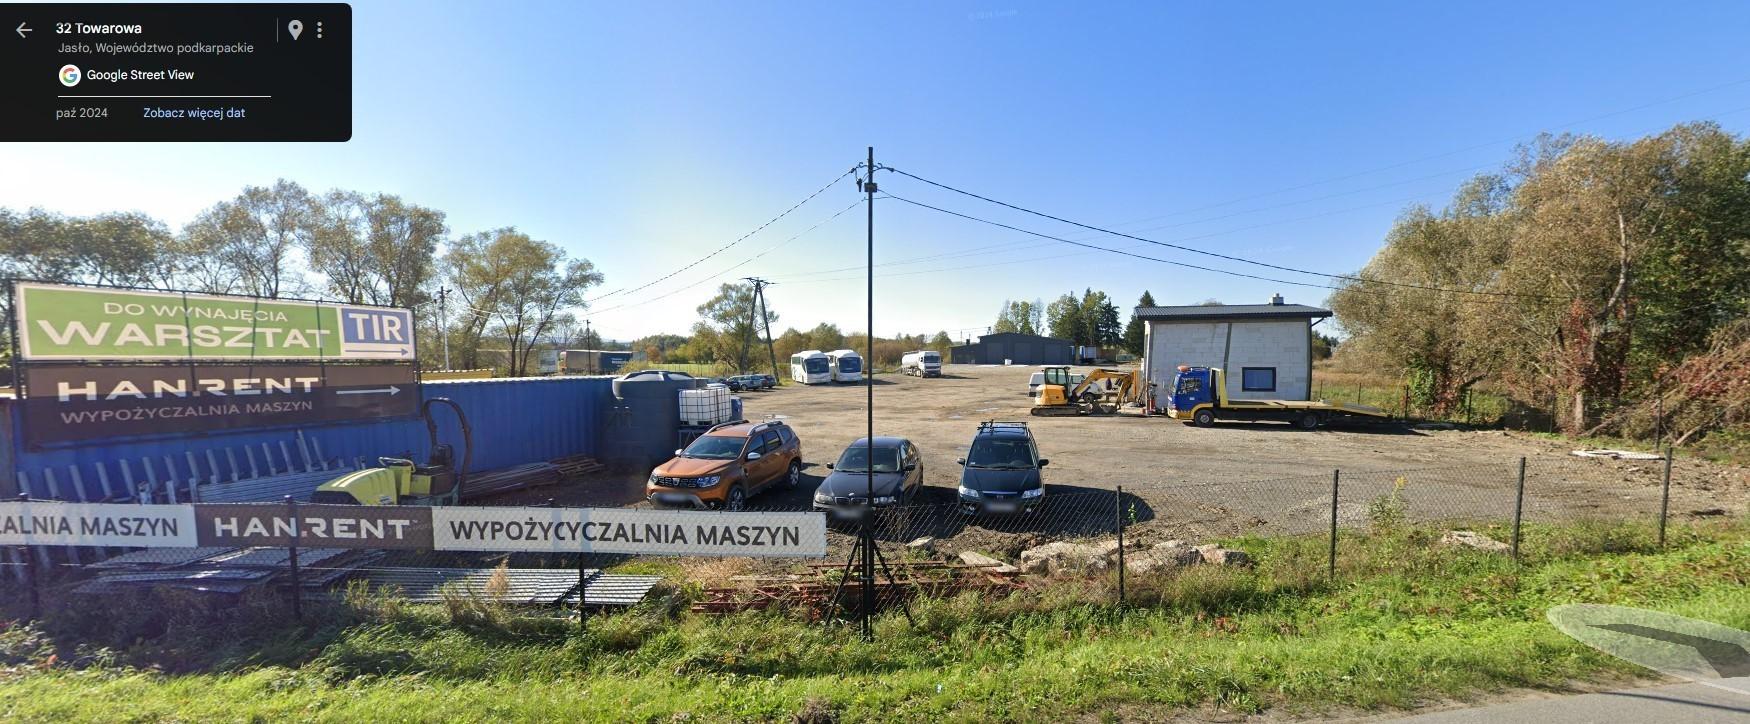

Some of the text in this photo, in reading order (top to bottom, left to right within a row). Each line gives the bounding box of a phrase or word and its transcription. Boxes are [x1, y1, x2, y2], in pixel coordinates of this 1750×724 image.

[104, 302, 288, 324] DO WYNAJĘCIA
[36, 319, 330, 349] WARSZTAT
[349, 312, 402, 341] TIR
[61, 400, 313, 424] WYPOŻYCZALNIA MASZYN
[0, 515, 179, 537] ALNIA MASZYN
[697, 526, 800, 546] MASZYN
